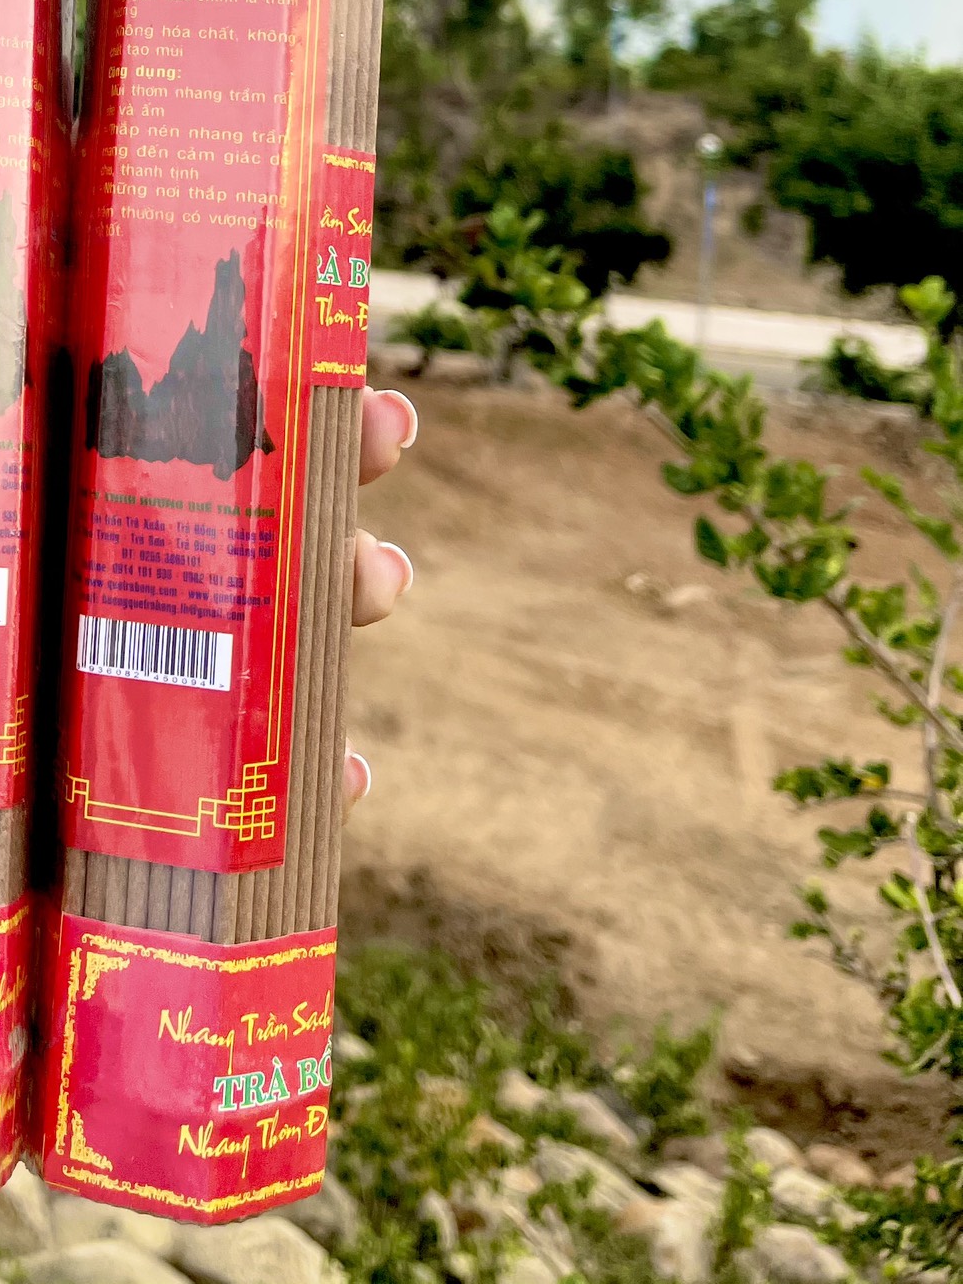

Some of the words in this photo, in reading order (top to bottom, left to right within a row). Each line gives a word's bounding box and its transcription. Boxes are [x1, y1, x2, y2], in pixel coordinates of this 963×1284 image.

[162, 25, 191, 38] hóa
[248, 29, 296, 46] không
[127, 44, 149, 59] tạo
[156, 44, 183, 57] mùi
[136, 66, 182, 81] dụng:
[131, 84, 168, 98] thơm
[175, 88, 222, 103] nhang
[119, 103, 134, 116] và
[148, 124, 180, 138] nén
[189, 127, 243, 144] nhang
[137, 144, 169, 158] đến
[176, 147, 215, 162] cảm
[224, 151, 261, 166] giác
[121, 164, 163, 178] thanh
[236, 191, 288, 206] nhang
[182, 209, 201, 223] có
[209, 214, 257, 230] vượng
[89, 665, 139, 679] 936082
[158, 1005, 235, 1075] Nhang
[241, 1013, 288, 1046] Trầm
[214, 1056, 290, 1112] TRÀ
[178, 1120, 251, 1178] Nhang
